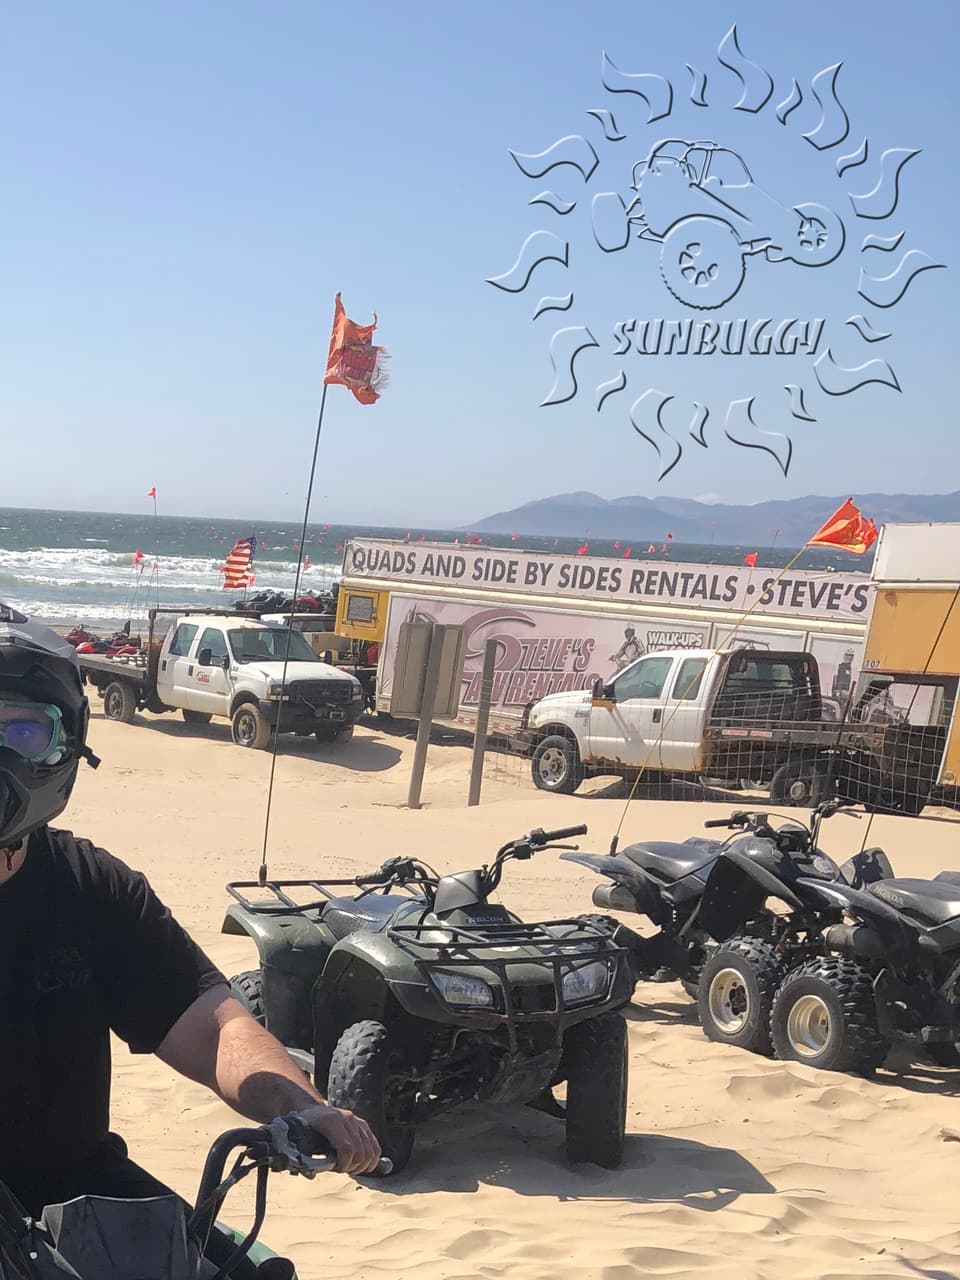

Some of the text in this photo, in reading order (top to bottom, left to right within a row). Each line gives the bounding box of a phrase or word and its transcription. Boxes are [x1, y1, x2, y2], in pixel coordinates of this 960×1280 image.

[352, 547, 870, 613] QUADS AND SIDE BY SIDES RENTALS STEVE'S
[647, 631, 704, 646] WALK-UPS
[873, 886, 905, 906] HONDA
